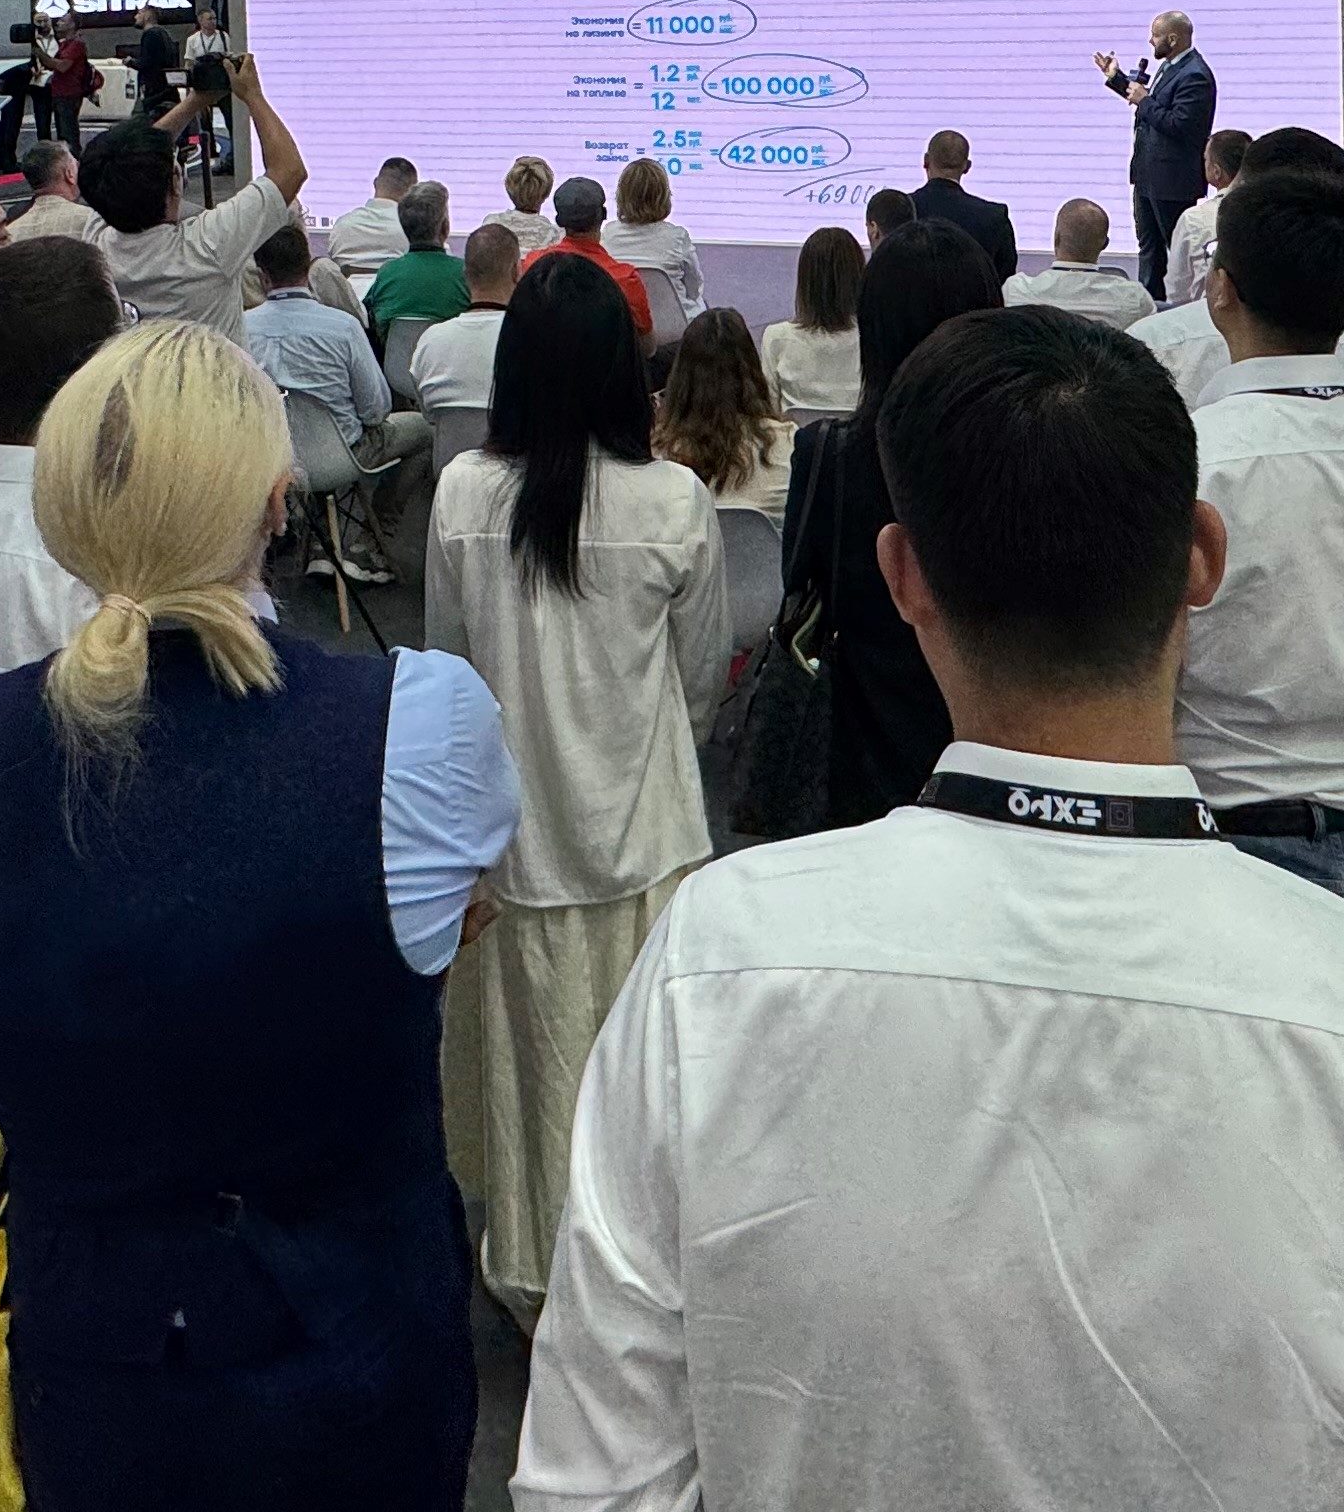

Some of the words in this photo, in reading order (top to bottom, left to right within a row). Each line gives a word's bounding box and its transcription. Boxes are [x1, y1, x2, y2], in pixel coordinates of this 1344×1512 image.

[571, 16, 624, 26] Экономия
[645, 16, 664, 34] 11
[669, 16, 715, 34] 000
[573, 75, 627, 85] Экономия
[649, 64, 680, 82] 1.2
[721, 76, 762, 95] 100
[767, 76, 815, 95] 000
[650, 92, 676, 110] 12
[585, 140, 629, 155] Возврат
[652, 129, 687, 148] 2.5
[727, 145, 756, 164] 42
[761, 145, 809, 164] 000
[1008, 787, 1102, 826] EXPO
